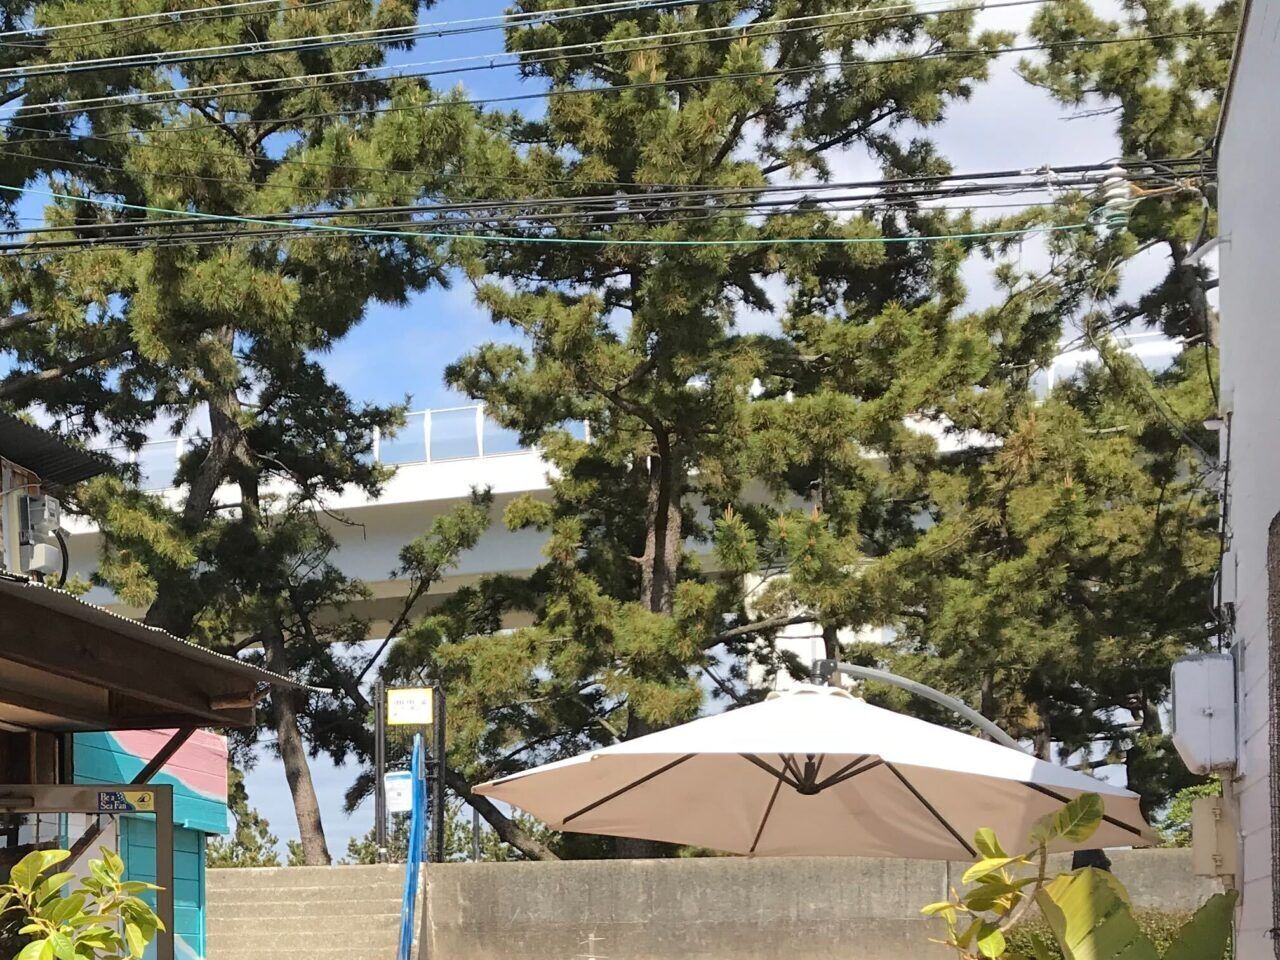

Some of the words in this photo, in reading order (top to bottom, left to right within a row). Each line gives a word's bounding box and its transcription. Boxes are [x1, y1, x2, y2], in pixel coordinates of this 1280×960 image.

[100, 792, 110, 801] Be
[100, 801, 113, 810] Sea
[114, 801, 127, 810] Fan
